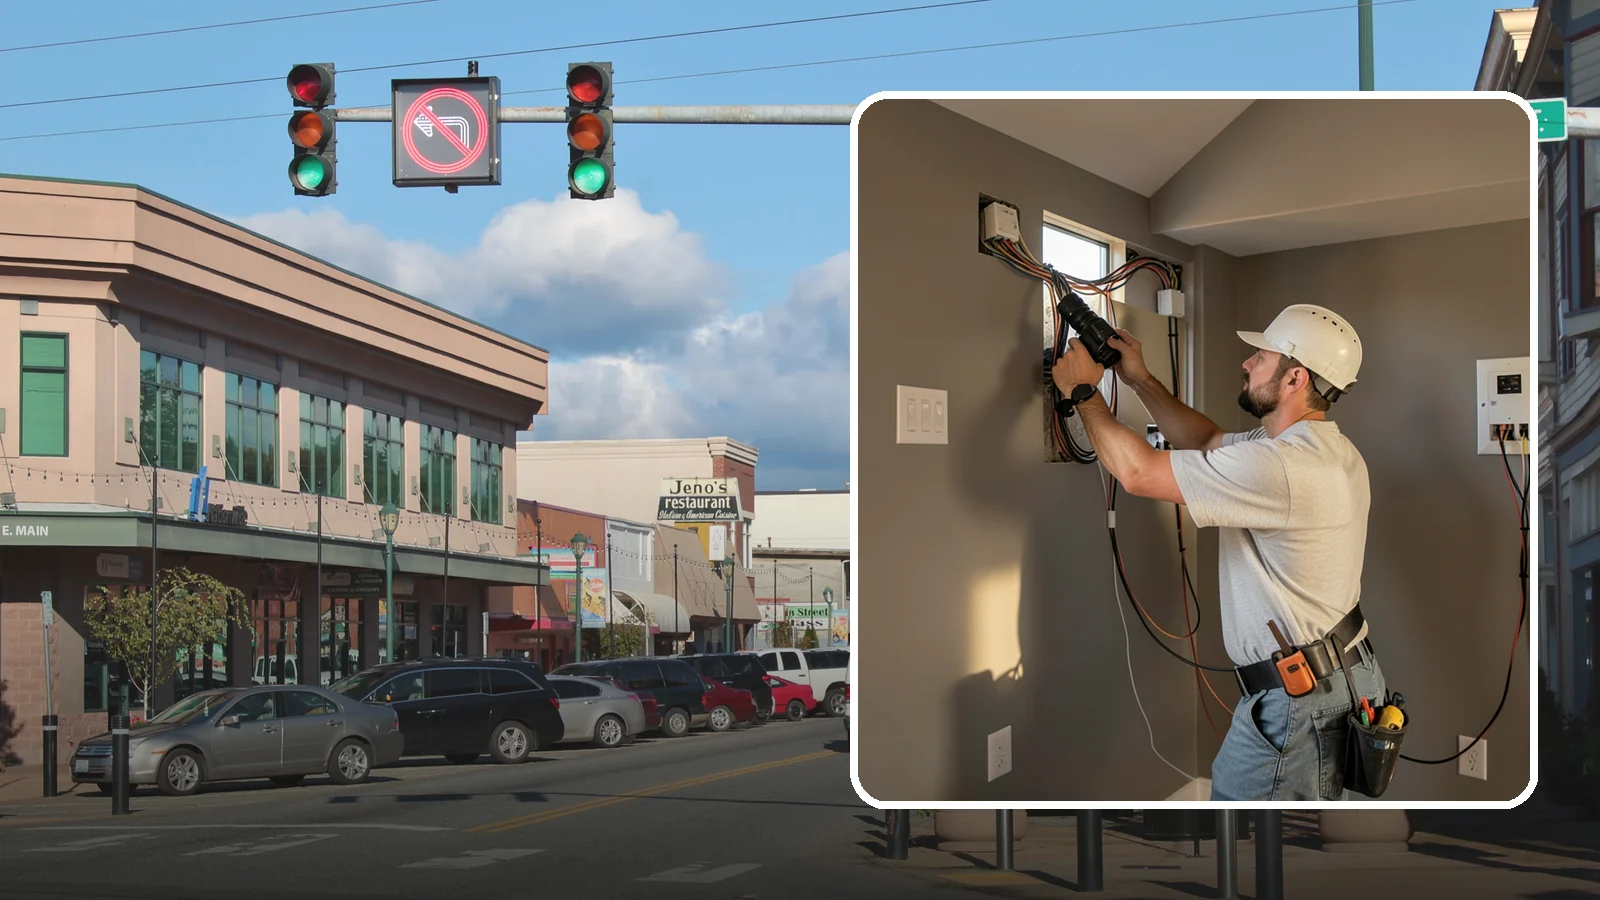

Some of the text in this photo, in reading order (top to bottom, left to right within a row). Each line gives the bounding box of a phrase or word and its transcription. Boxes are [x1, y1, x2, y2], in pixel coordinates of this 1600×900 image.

[670, 480, 728, 494] Jeno's
[665, 496, 731, 509] restaurant
[658, 509, 681, 519] Italian
[685, 509, 714, 519] American
[714, 509, 737, 519] Cuisine
[2, 525, 49, 536] E. MAIN
[797, 607, 828, 616] Street
[791, 619, 823, 627] lass
